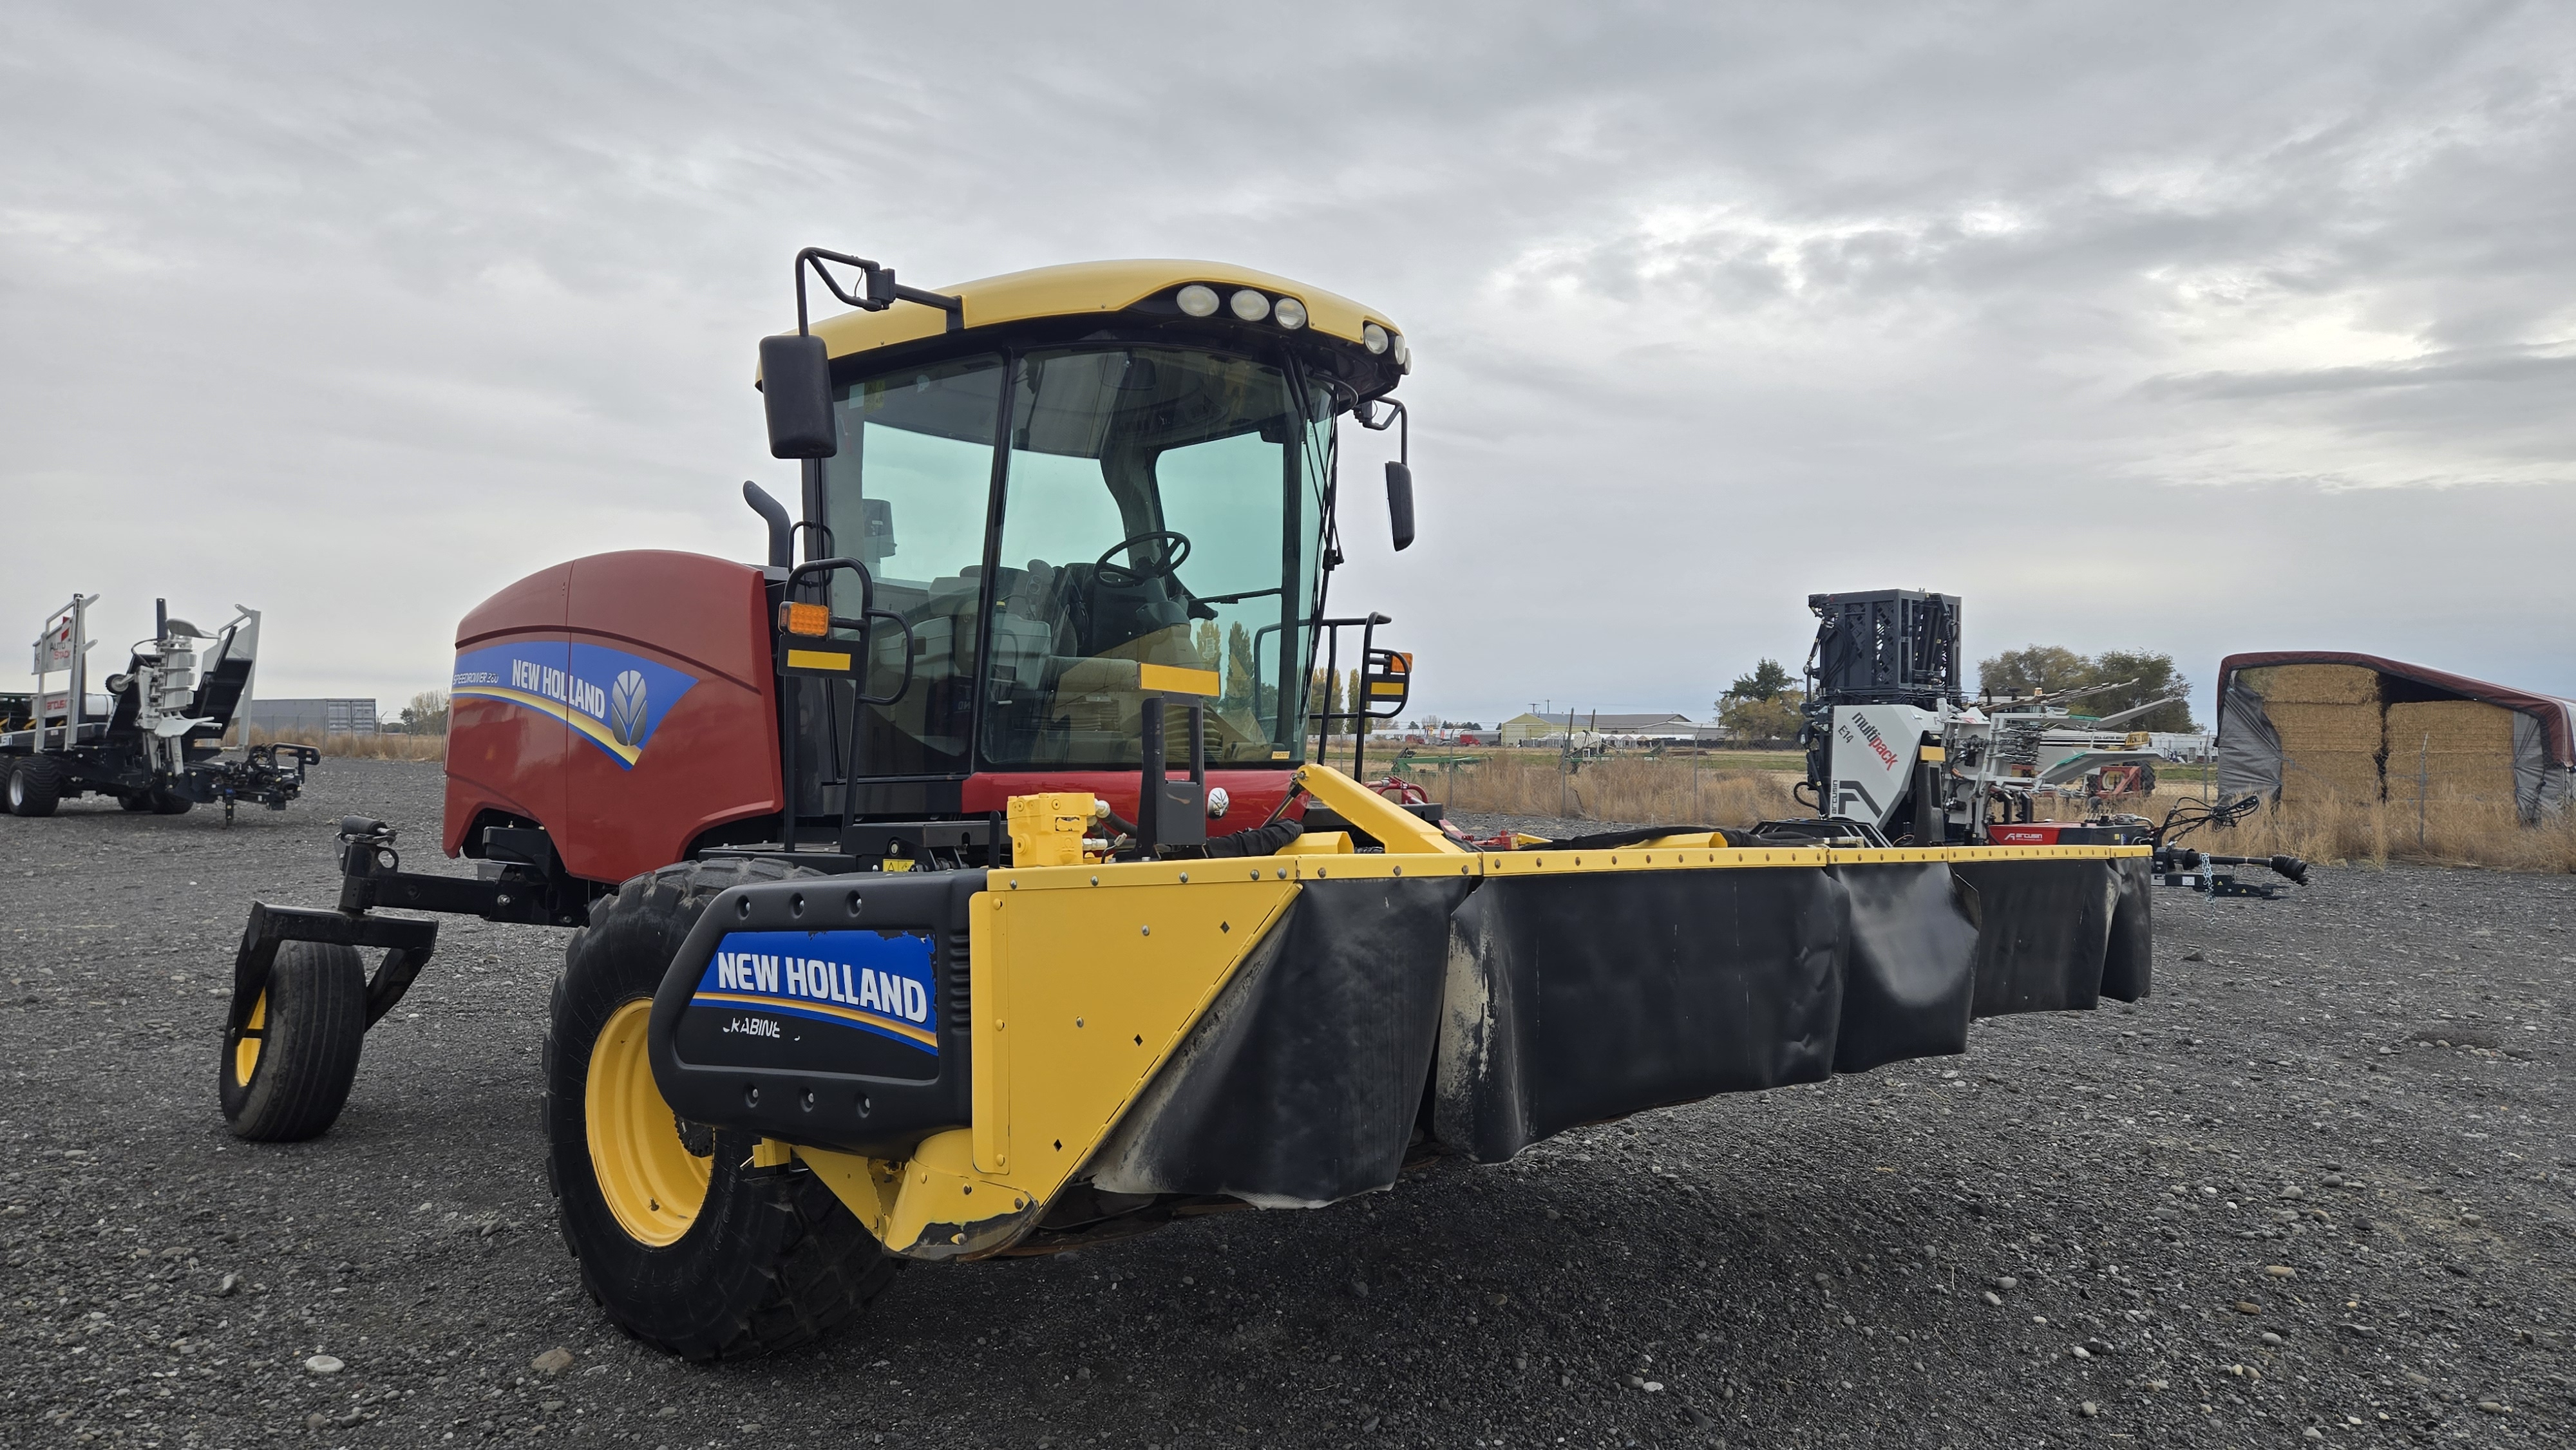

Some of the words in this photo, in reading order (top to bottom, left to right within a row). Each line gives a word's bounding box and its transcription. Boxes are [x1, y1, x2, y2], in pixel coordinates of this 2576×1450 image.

[50, 642, 66, 652] AUTO
[453, 672, 488, 685] SPEEDROWER
[512, 659, 540, 691] NEW
[542, 666, 605, 719] HOLLAND
[1838, 724, 1854, 744] E14
[1852, 711, 1899, 771] multipack
[718, 952, 779, 993] NEW
[785, 957, 927, 1023] HOLLAND
